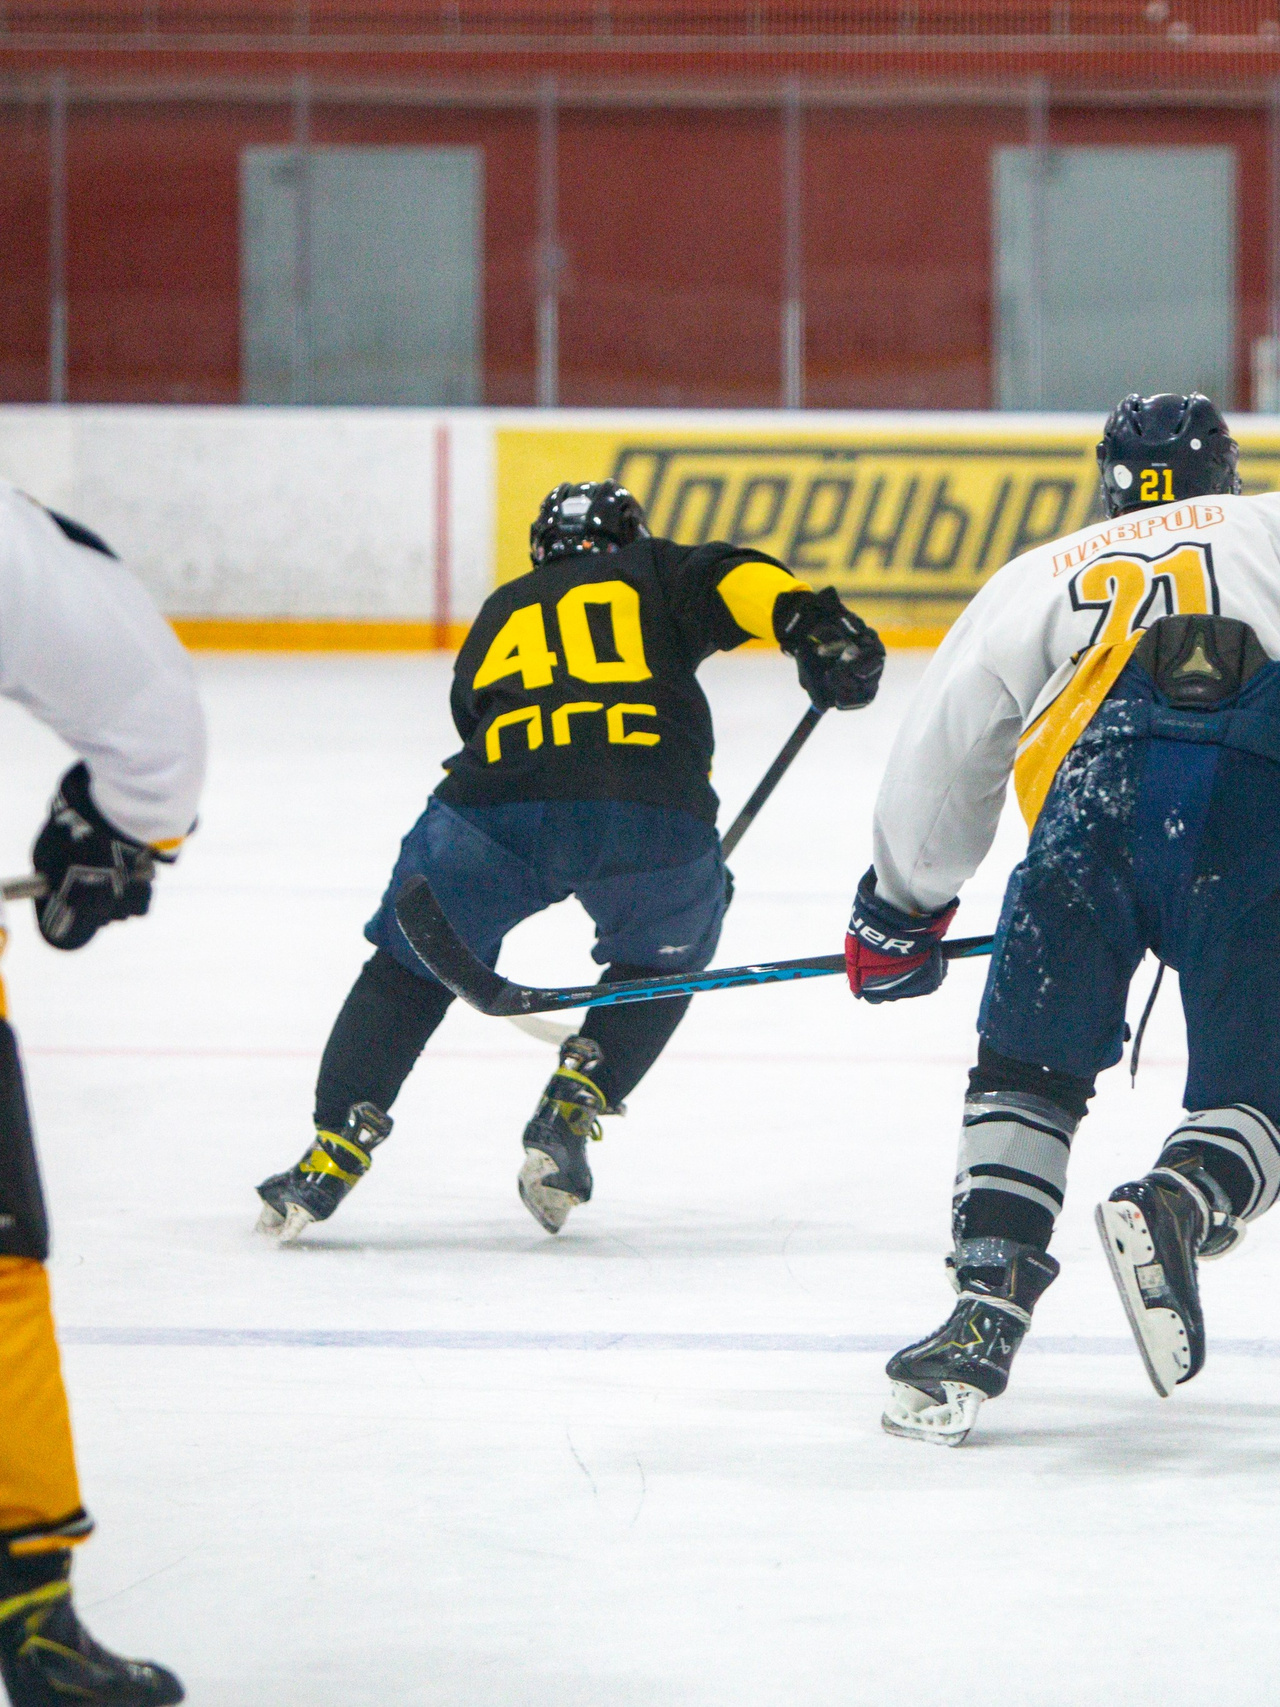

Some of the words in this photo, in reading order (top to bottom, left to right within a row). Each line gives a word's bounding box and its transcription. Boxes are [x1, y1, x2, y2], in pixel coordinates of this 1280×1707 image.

[1140, 469, 1175, 501] 21
[1053, 505, 1225, 577] ЛАВРОВ
[1069, 541, 1220, 648] 21
[473, 580, 653, 690] 40
[485, 701, 661, 763] ПГС
